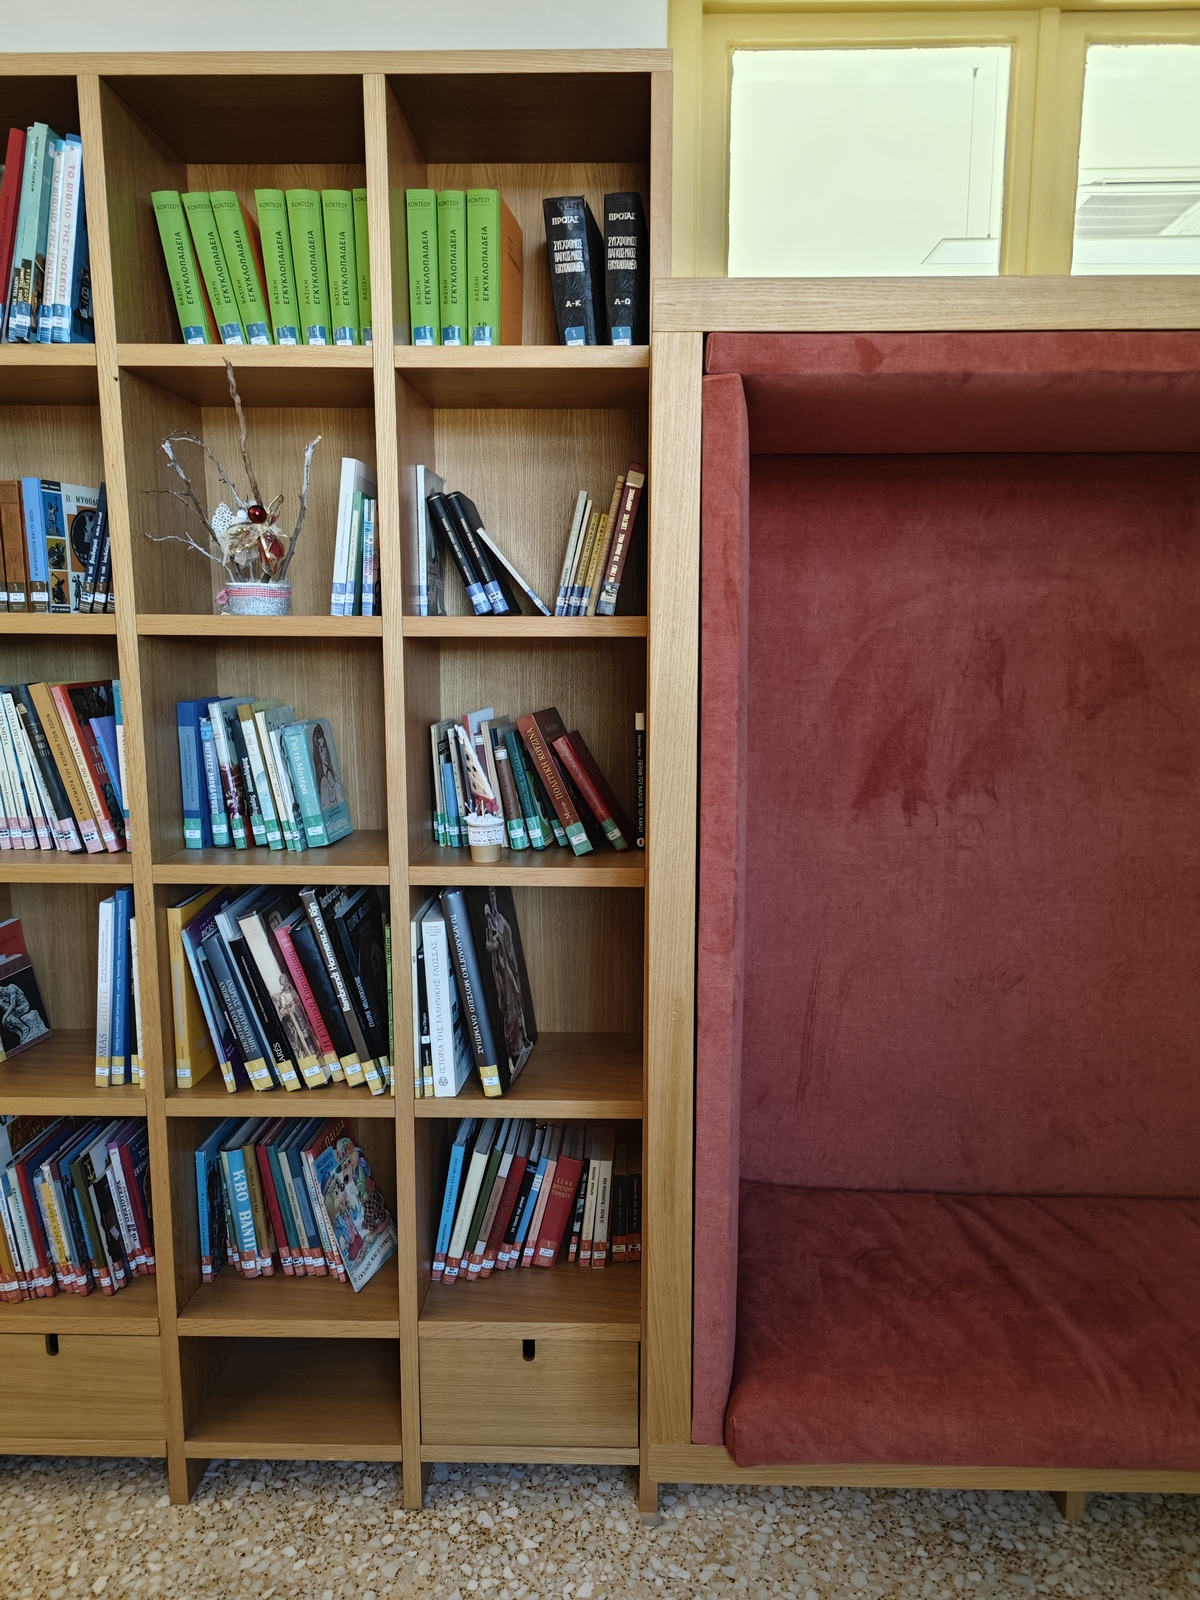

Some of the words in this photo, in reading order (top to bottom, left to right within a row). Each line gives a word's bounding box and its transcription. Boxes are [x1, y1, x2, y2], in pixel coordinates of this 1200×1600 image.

[54, 169, 60, 183] ΤΟ
[68, 164, 75, 178] ΤΟ
[51, 187, 59, 223] ΒΙΒΛΙΟ
[64, 182, 73, 218] ΒΙΒΛΙΟ
[62, 223, 70, 244] ΤΗΣ
[44, 252, 54, 302] ΓΝΩΣΕΩΣ
[58, 248, 69, 299] ΓΝΩΣΕΩΣ
[175, 232, 194, 304] ΕΓΚΥΚΛΟΠΑΙΔΕΙΑ
[208, 232, 231, 304] ΕΓΚΥΚΛΟΠΑΙΔΕΙΑ
[234, 230, 256, 302] ΕΓΚΥΚΛΟΠΑΙΔΕΙΑ
[276, 231, 289, 304] ΕΓΚΥΚΛΟΠΑΙΔΕΙΑ
[308, 230, 320, 304] ΕΓΚΥΚΛΟΠΑΙΔΕΙΑ
[339, 232, 349, 305] ΕΓΚΥΚΛΟΠΑΙΔΕΙΑ
[422, 230, 431, 304] ΕΓΚΥΚΛΟΠΑΙΔΕΙΑ
[176, 281, 184, 306] ΒΑΣΙΚΗ
[212, 281, 221, 305] ΒΑΣΙΚΗ
[237, 280, 246, 304] ΒΑΣΙΚΗ
[76, 496, 98, 506] ΜΥΘΟΛ
[584, 522, 595, 553] ΑΘΑΝΑΤΗ
[593, 525, 604, 554] ΑΘΑΝΑΤΗ
[31, 540, 39, 570] ΜΥΘΟΛΟΓΙΑ
[577, 555, 587, 581] ΕΛΛΑΔΑ
[45, 713, 55, 729] ΖΩΩΝ
[51, 730, 59, 742] ΤΩΝ
[56, 743, 68, 766] ΚΟΣΜΟΥ
[69, 735, 84, 765] ΖΟΥΓΚΛΑΣ
[203, 741, 214, 771] ΜΕΓΑΛΕΣ
[525, 727, 546, 761] ΚΟΥΖΙΝΑ
[64, 767, 72, 778] ΤΟΥ
[80, 766, 88, 778] ΤΗΣ
[294, 761, 309, 794] Μητέρα
[540, 760, 563, 799] ΠΟΛΙΤΙΚΗ
[68, 779, 82, 806] ΘΑΥΜΑΤΑ
[84, 779, 99, 807] ΘΑΥΜΑΤΑ
[207, 772, 220, 815] ΑΝΑΚΑΛΥΨΕΙΣ
[78, 806, 84, 814] ΤΑ
[95, 808, 102, 817] ΤΑ
[306, 900, 321, 918] Rijn
[314, 916, 324, 931] van
[449, 913, 457, 923] ΤΟ
[317, 930, 337, 971] Harmensz.
[431, 940, 439, 974] ΓΛΩΣΣΑΣ
[451, 923, 469, 978] ΑΡΧΑΙΟΛΟΓΙΚΟ
[287, 949, 314, 1001] Επανάσταση
[329, 970, 350, 1012] Rembrandt
[433, 978, 442, 1023] ΕΛΛΗΝΙΚΗΣ
[463, 979, 475, 1012] ΜΟΥΣΕΙΟ
[217, 980, 234, 1011] ANDREAS
[229, 1010, 250, 1054] VOURLOUMIS
[224, 978, 239, 1007] ΑΝΔΡΕΑΣ
[235, 1008, 256, 1052] ΒΟΥΡΛΟΥΜΗΣ
[307, 1001, 328, 1038] Ελληνική
[322, 1038, 331, 1048] Η
[470, 1014, 484, 1055] ΟΛΥΜΠΙΑΣ
[115, 1180, 130, 1222] ΩΡΑΙΟΤΕΡΑ
[233, 1169, 249, 1202] ΚΒΟ
[551, 1190, 571, 1198] ΓΗΜΑΤΑ
[46, 1202, 56, 1223] ΟΔΗΓΟ
